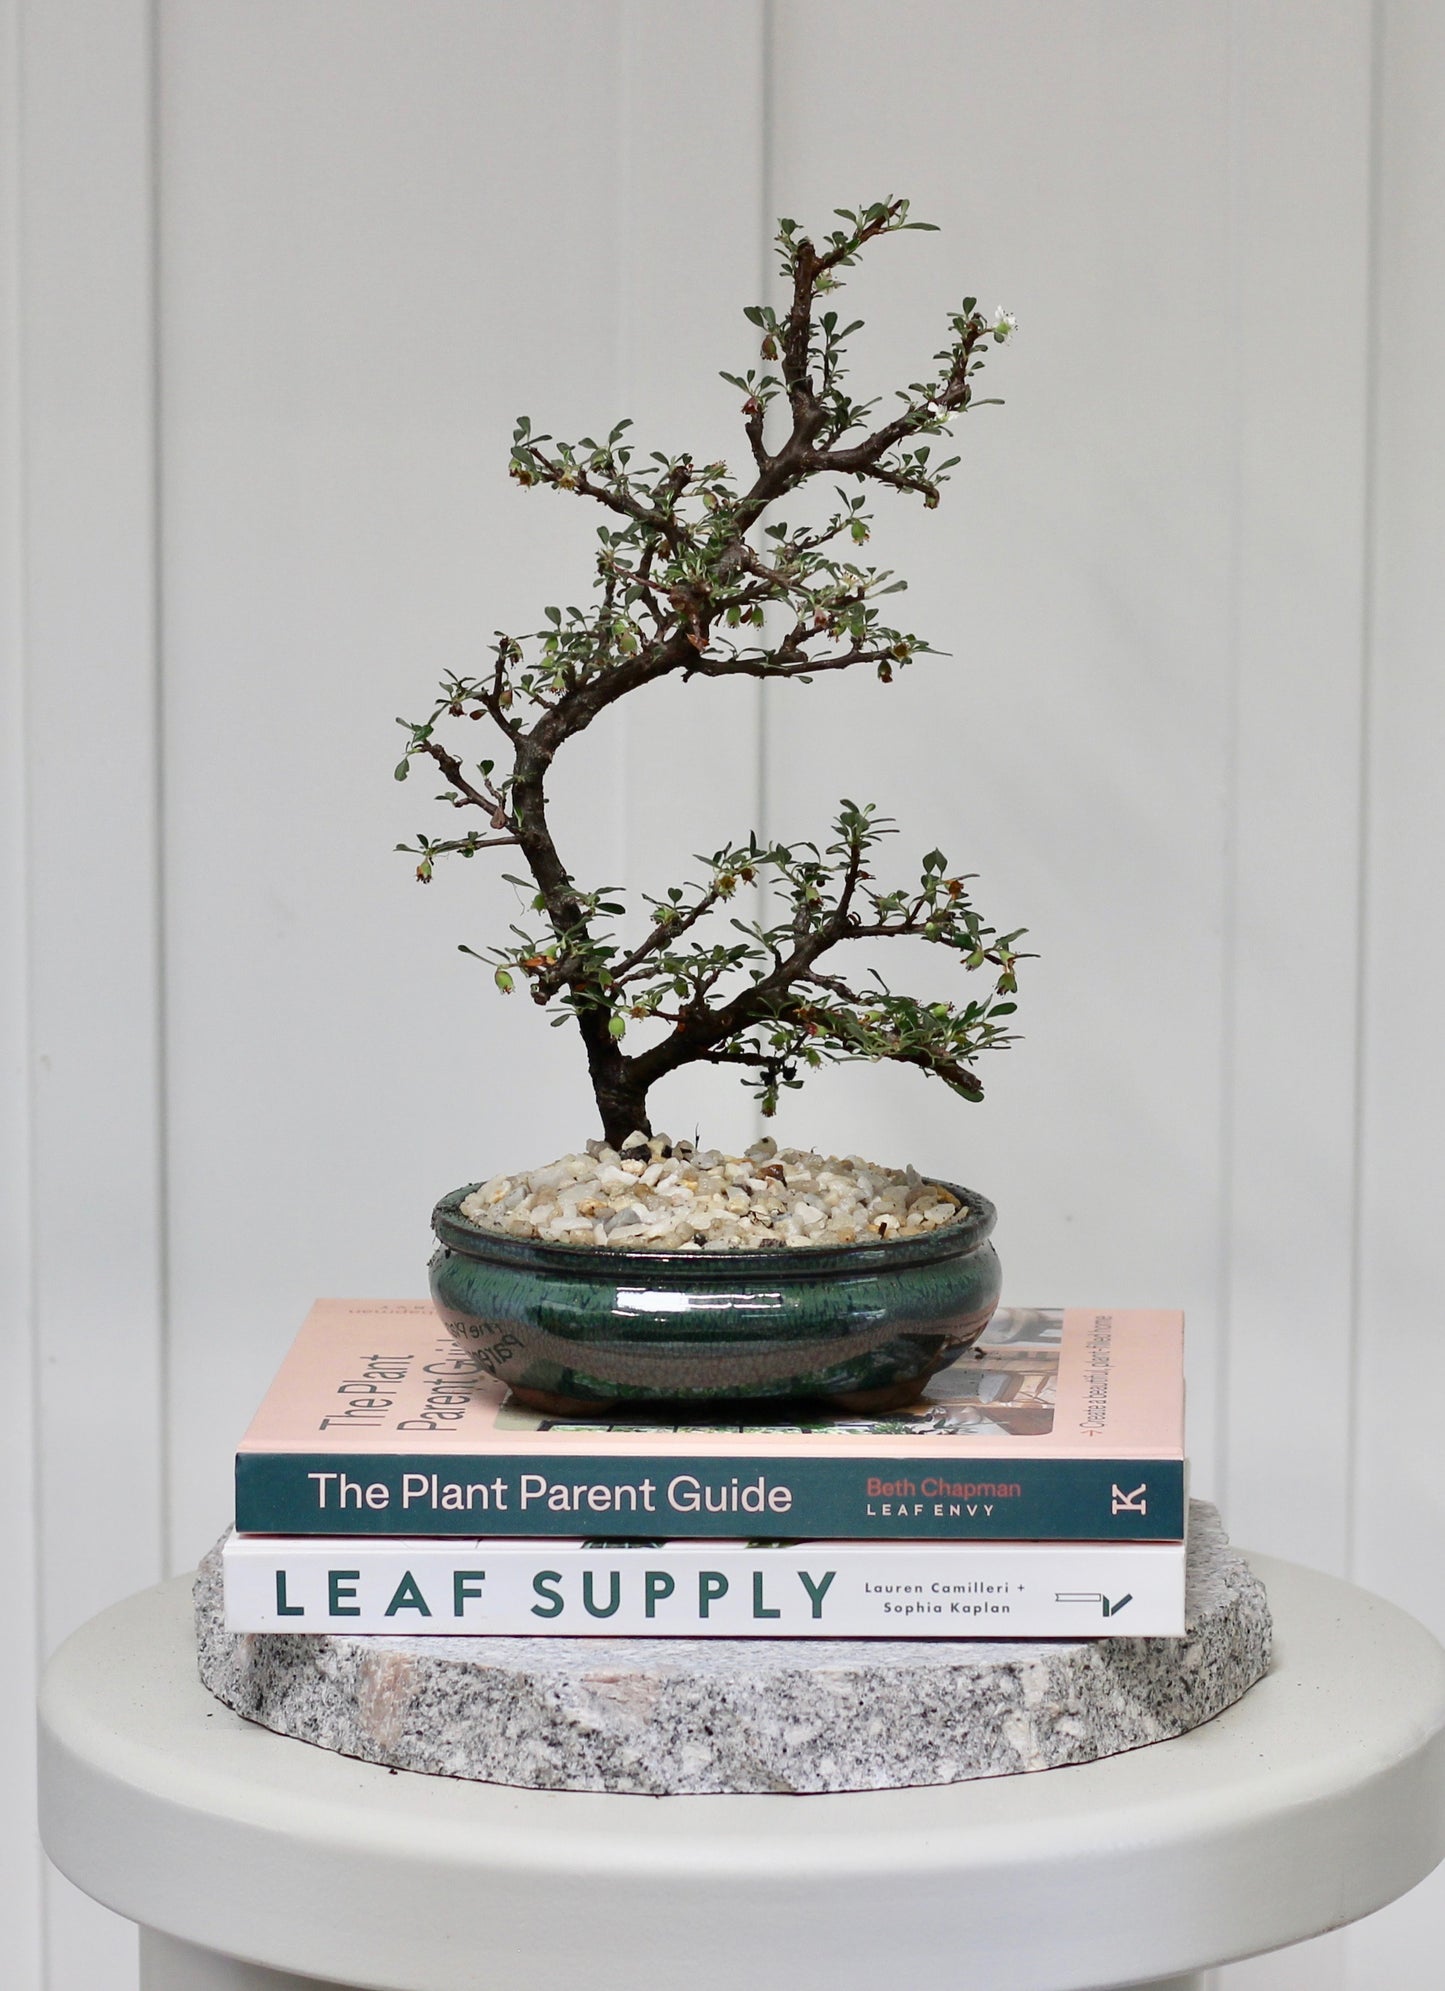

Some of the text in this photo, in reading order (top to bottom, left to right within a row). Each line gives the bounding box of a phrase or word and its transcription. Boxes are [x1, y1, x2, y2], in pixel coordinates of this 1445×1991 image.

[337, 1354, 415, 1394] Plant
[318, 1398, 393, 1431] The
[396, 1379, 479, 1431] Parent
[308, 1473, 792, 1513] The Plant Parent Guide
[866, 1477, 1021, 1500] Beth Chapman
[1112, 1483, 1147, 1515] K
[867, 1504, 994, 1516] LEAF ENVY
[275, 1570, 837, 1619] LEAF SUPPLY
[865, 1582, 923, 1594] Lauren
[931, 1581, 1009, 1594] Camilleri
[883, 1602, 1010, 1616] Sophia Kaplan
